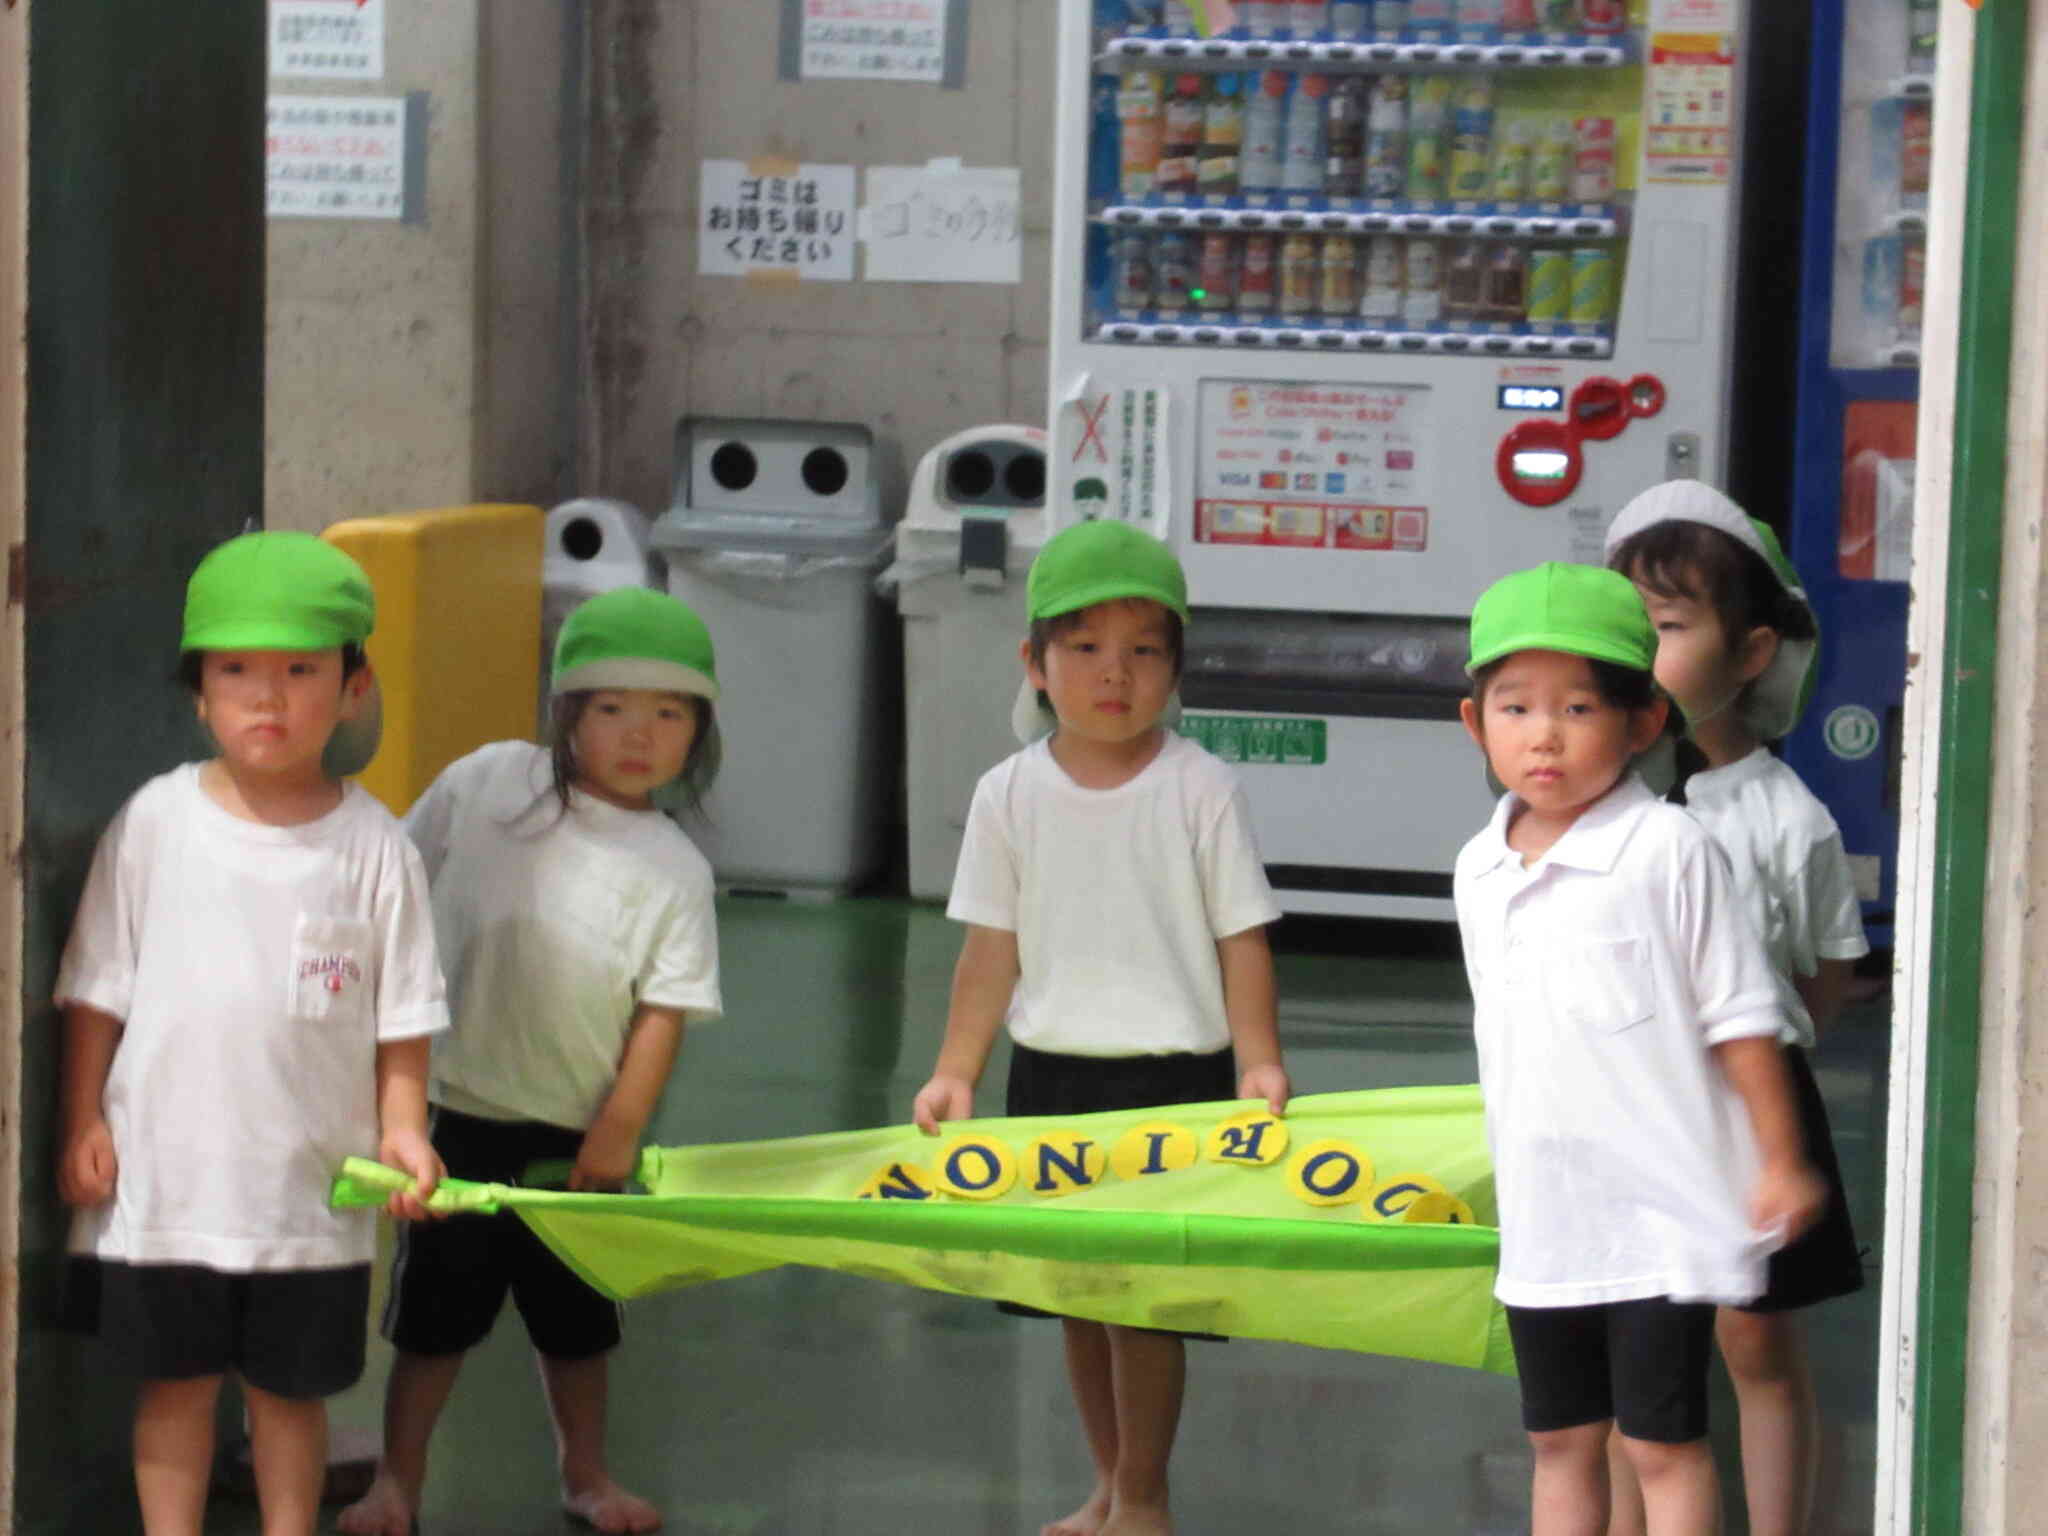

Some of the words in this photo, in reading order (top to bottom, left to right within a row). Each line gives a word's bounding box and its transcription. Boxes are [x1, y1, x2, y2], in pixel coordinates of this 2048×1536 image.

[739, 177, 819, 205] ゴミは
[707, 205, 845, 236] お持ち帰り
[724, 237, 832, 264] ください
